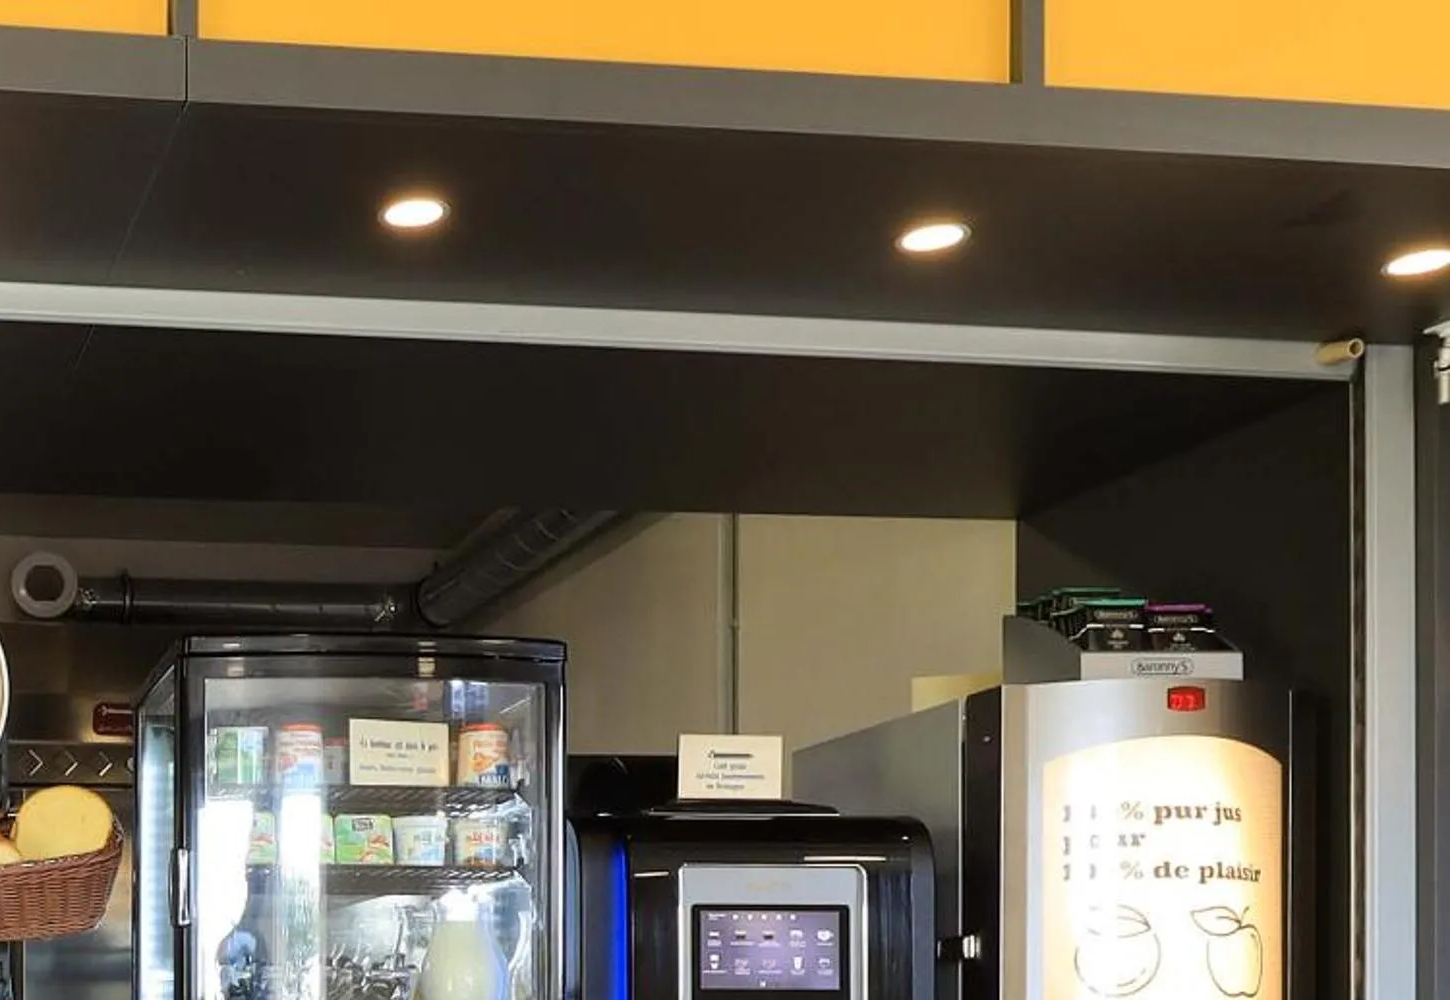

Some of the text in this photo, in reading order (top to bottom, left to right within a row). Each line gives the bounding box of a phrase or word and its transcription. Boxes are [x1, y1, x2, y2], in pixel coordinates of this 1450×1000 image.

[1153, 804, 1209, 825] pur
[1213, 800, 1242, 826] jus
[1153, 860, 1190, 879] de
[1198, 861, 1262, 885] plaisir
